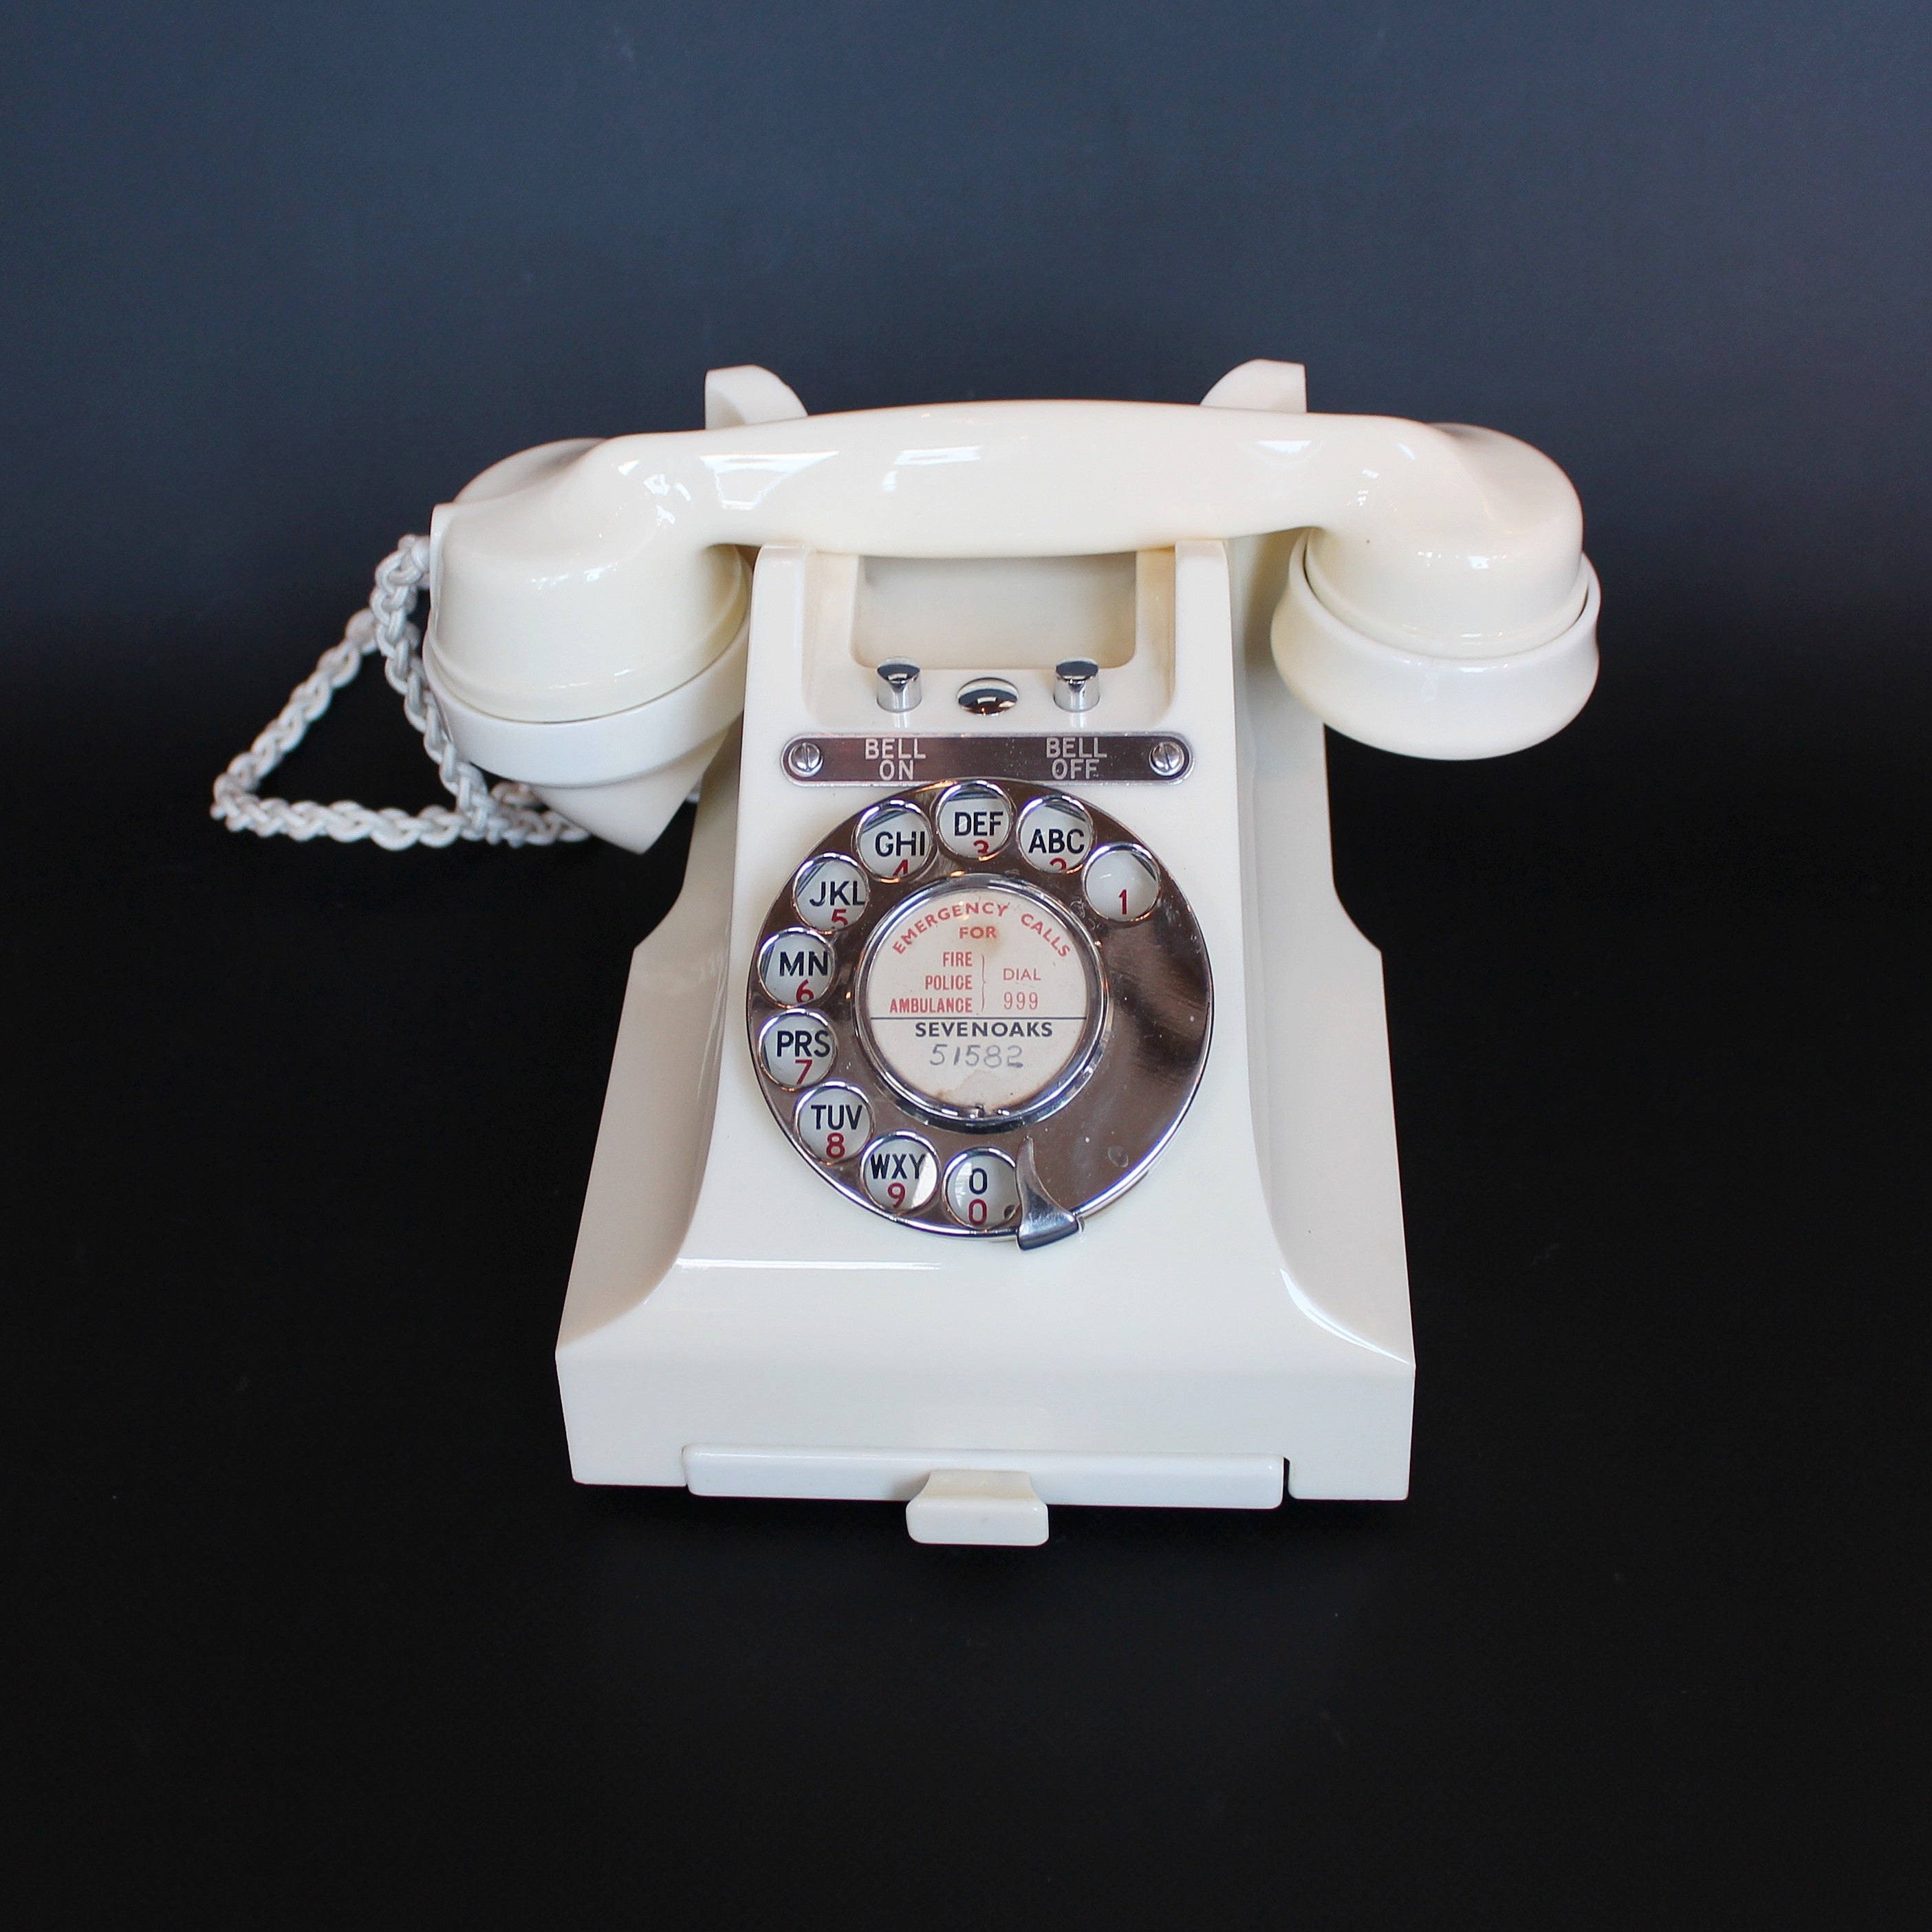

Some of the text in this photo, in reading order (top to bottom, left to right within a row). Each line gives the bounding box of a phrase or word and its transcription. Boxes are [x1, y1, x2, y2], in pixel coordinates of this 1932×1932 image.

[865, 738, 926, 759] BELL
[1045, 737, 1107, 758] BELL
[878, 760, 914, 781] ON
[1051, 759, 1099, 780] OFF
[954, 811, 1004, 836] DEF
[874, 831, 926, 858] GHI
[1028, 828, 1085, 854] ABC
[809, 880, 866, 907] JKL
[1118, 889, 1127, 915] 1
[830, 908, 849, 926] 5
[892, 901, 1071, 958] EMERGENCY CALLS
[958, 926, 997, 940] FOR
[779, 951, 828, 977] MN
[942, 951, 973, 967] FIRE
[925, 975, 973, 990] POLICE
[1002, 968, 1041, 981] DIAL
[795, 979, 814, 1003] 6
[1003, 991, 1039, 1010] 999
[889, 997, 973, 1013] AMBULANCE
[915, 1021, 1054, 1037] SEVENOAKS
[777, 1030, 831, 1058] PRS
[929, 1043, 1023, 1068] 51582
[794, 1059, 813, 1085] 7
[811, 1105, 862, 1130] TUV
[826, 1133, 846, 1159] 8
[870, 1153, 926, 1180] WXY
[887, 1182, 907, 1208] 9
